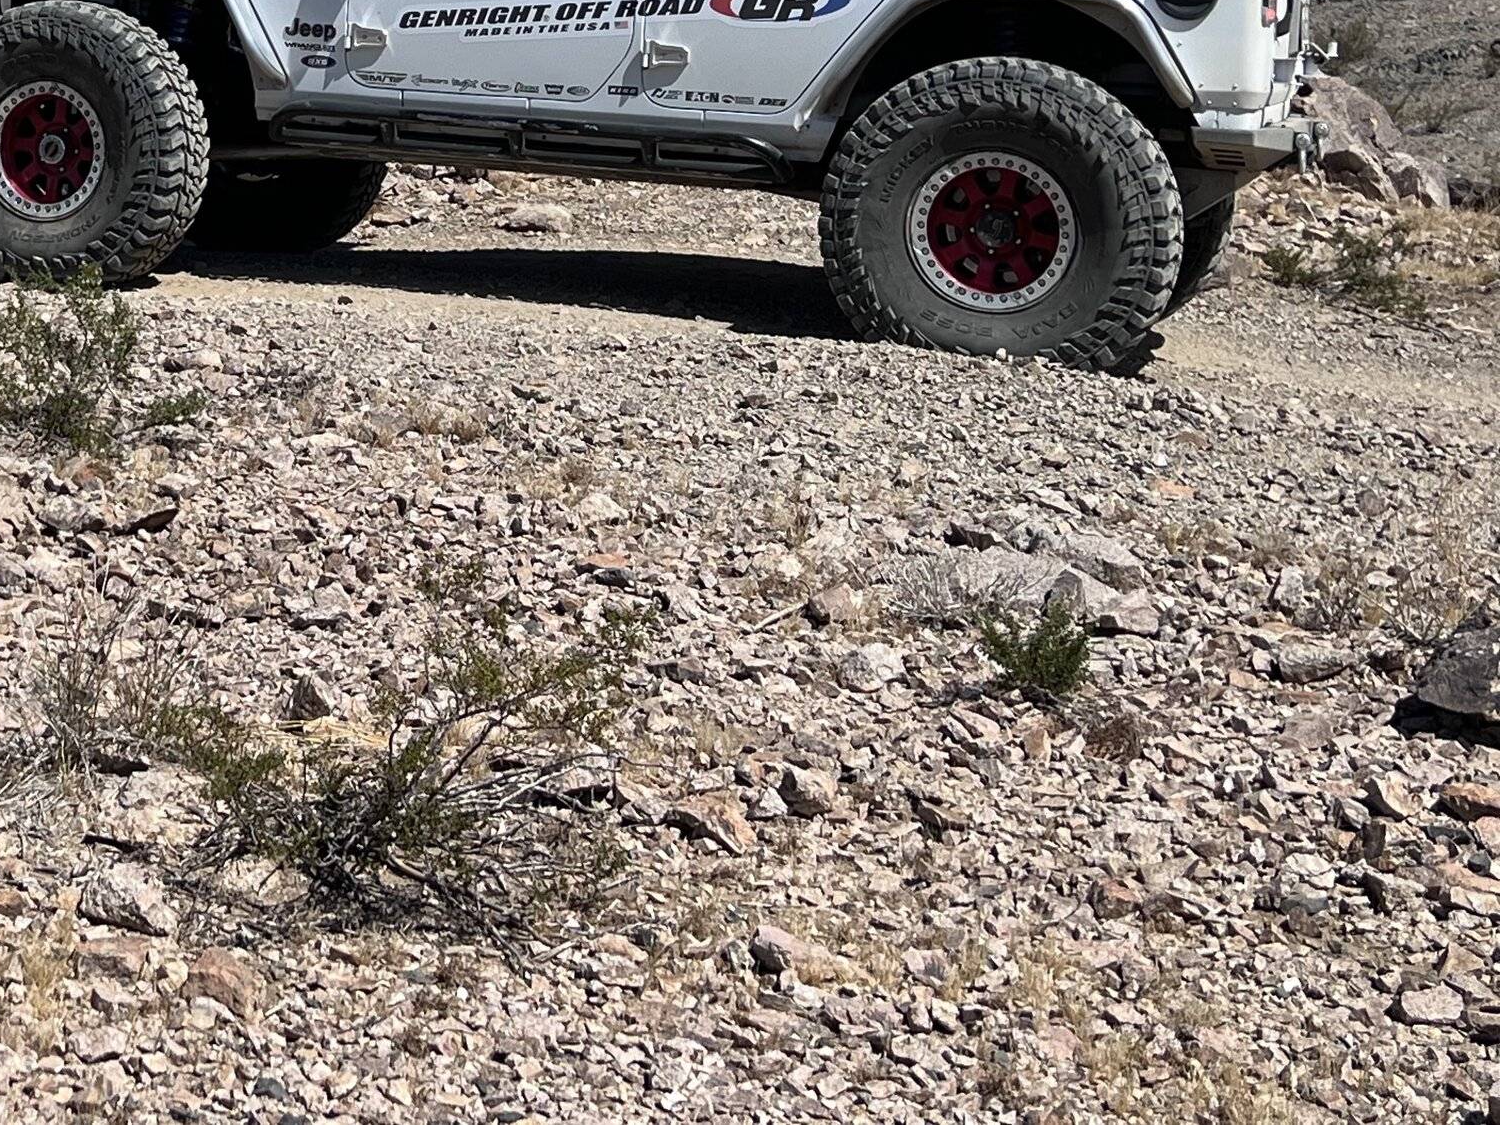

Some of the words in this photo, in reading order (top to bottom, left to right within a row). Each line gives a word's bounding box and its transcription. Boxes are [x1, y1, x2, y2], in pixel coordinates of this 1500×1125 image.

[399, 5, 551, 29] GENRIGHT
[554, 1, 612, 21] OFF
[285, 18, 337, 42] Jeep
[464, 27, 512, 38] MADE
[515, 26, 533, 35] IN
[538, 24, 569, 34] THE
[574, 22, 610, 32] USA
